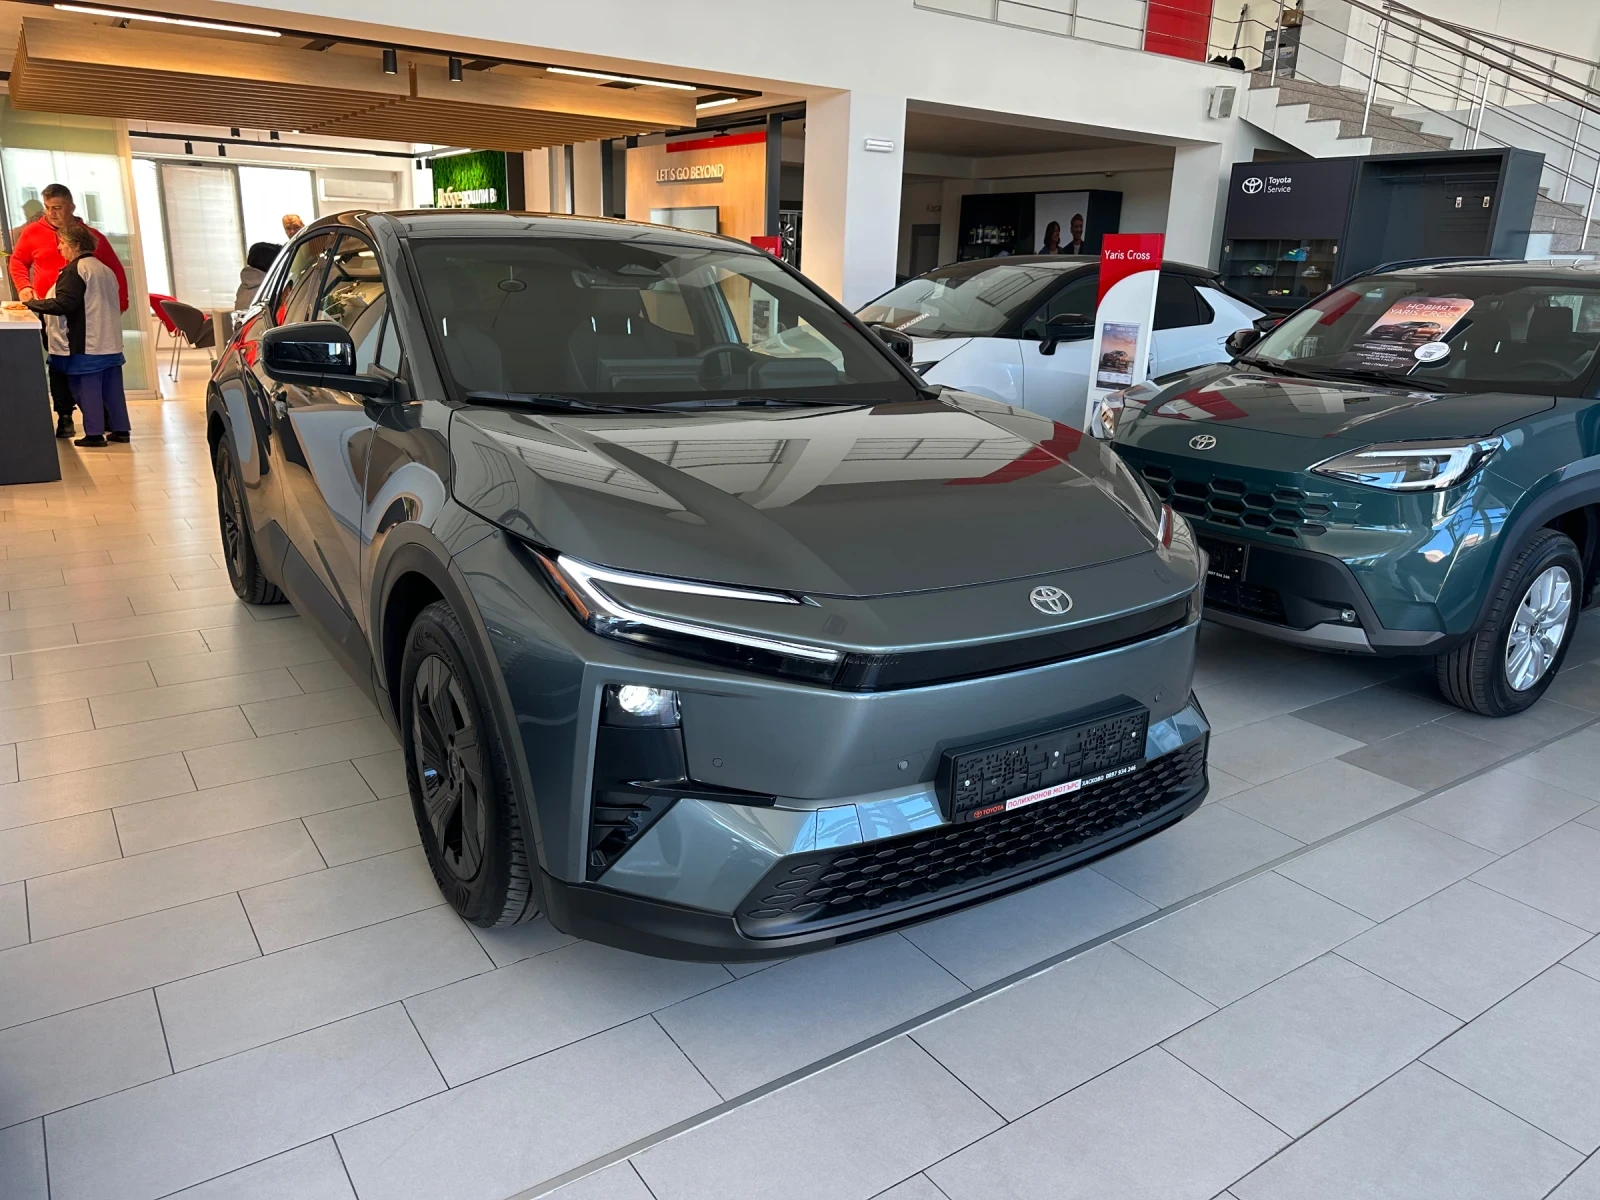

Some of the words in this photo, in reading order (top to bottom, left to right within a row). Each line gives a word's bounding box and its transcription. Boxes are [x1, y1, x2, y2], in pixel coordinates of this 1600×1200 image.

[656, 167, 676, 182] LET'S
[676, 166, 690, 180] GO
[690, 163, 724, 179] BEYOND
[1268, 176, 1292, 186] Toyota
[1267, 185, 1292, 194] Service
[1104, 249, 1125, 260] Yaris
[1127, 249, 1151, 260] Cross
[1406, 303, 1456, 312] НОВИЯТ
[1390, 308, 1420, 316] YARIS
[1421, 310, 1459, 318] CROSS
[983, 804, 1004, 816] TOYOTA
[1007, 790, 1052, 809] ПОЛИХРОНОВ
[1053, 781, 1079, 795] МОТЪРС
[1081, 774, 1104, 787] ХАСКОВО
[1118, 768, 1127, 776] 934
